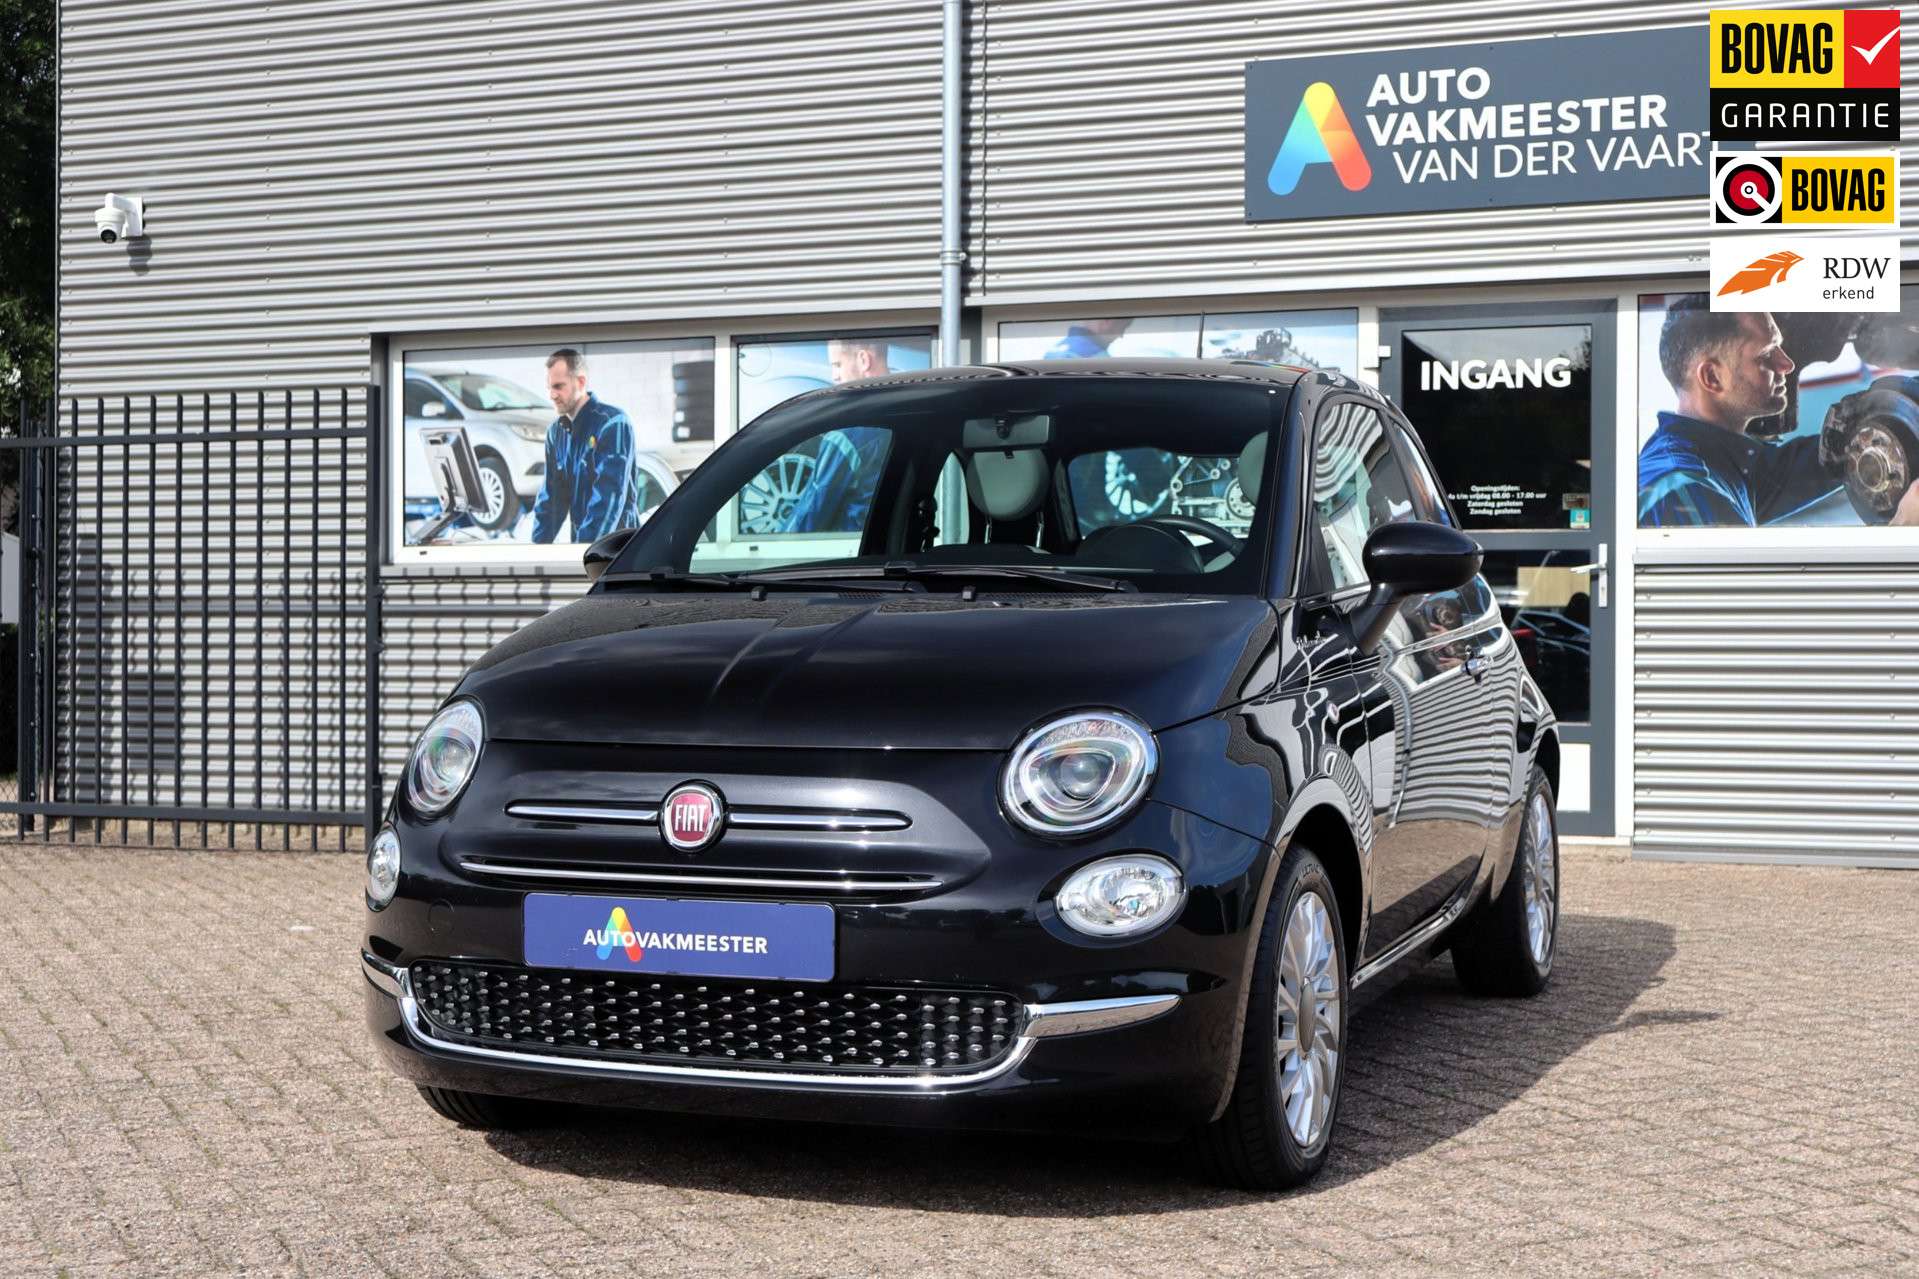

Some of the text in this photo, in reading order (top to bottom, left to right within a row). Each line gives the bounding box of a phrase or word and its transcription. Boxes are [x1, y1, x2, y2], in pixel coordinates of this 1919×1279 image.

[1366, 67, 1490, 107] AUTO
[1365, 94, 1668, 146] VAKMEESTER
[1393, 146, 1478, 183] VAN
[1494, 140, 1577, 178] DER
[1421, 358, 1572, 390] INGANG
[674, 803, 708, 832] FIAT
[583, 928, 768, 954] AUTOVAKMEESTER
